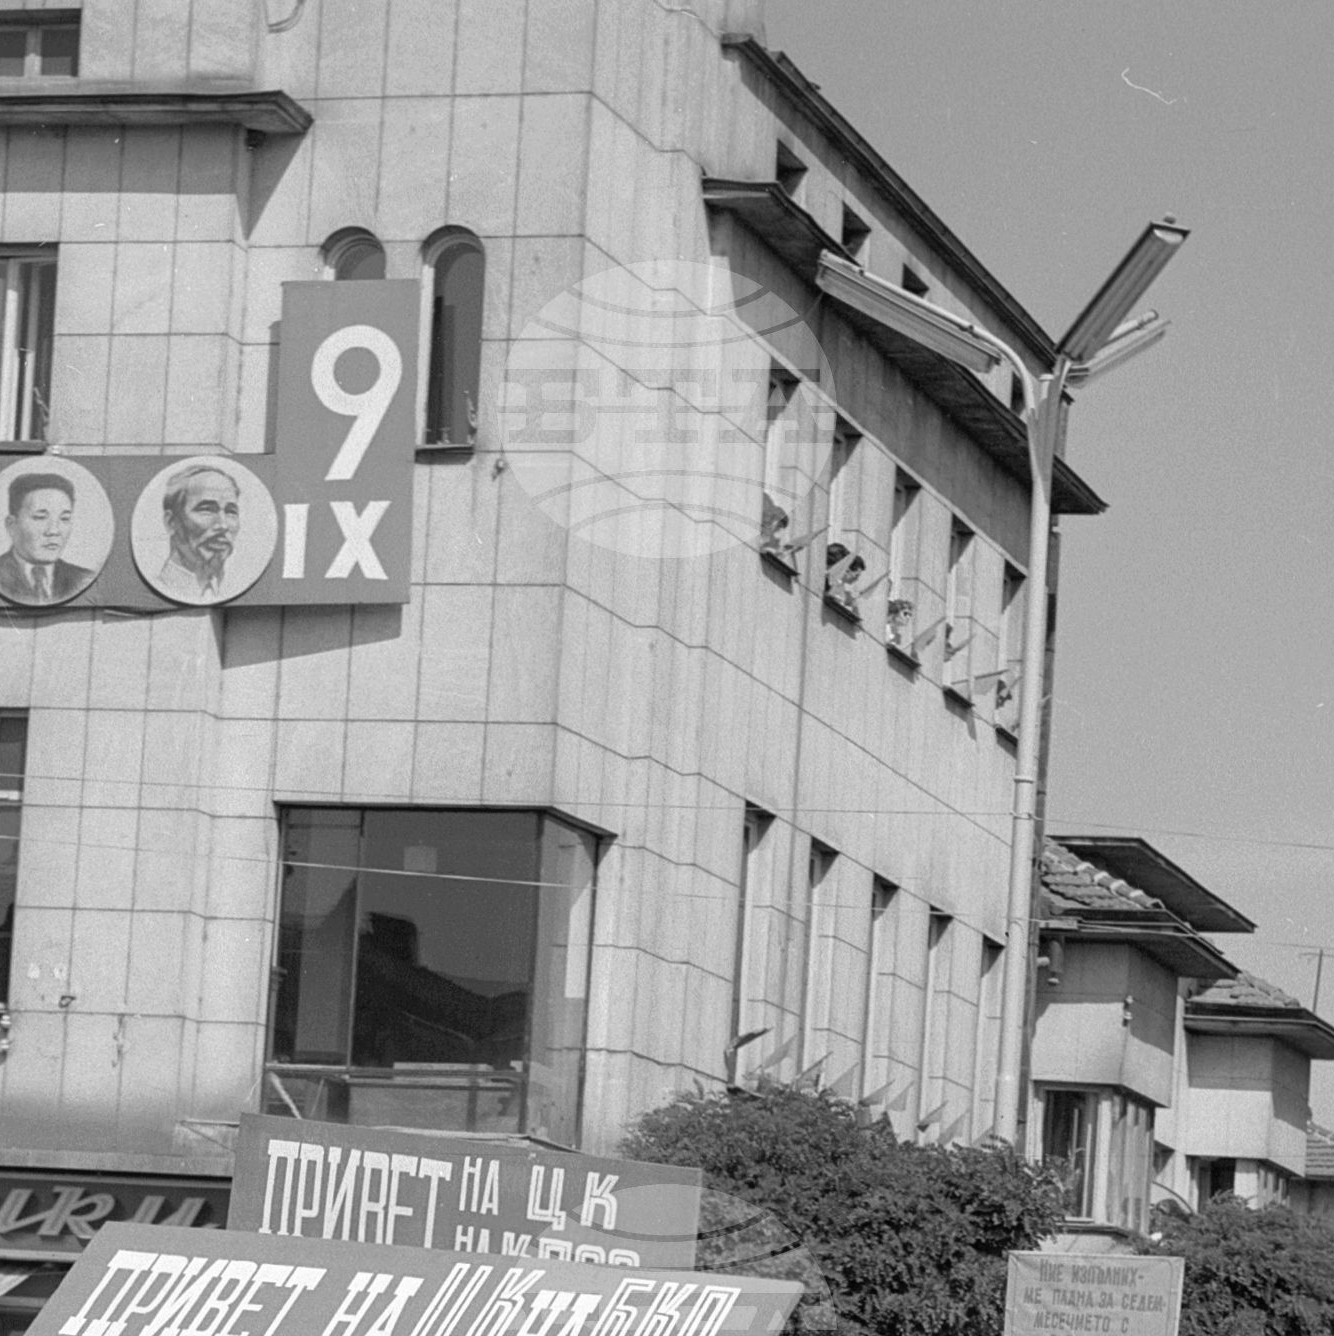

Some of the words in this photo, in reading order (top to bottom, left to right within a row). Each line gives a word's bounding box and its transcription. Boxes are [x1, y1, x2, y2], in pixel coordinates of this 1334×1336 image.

[311, 325, 403, 481] 9
[259, 1139, 453, 1249] ПРИВЕТ
[458, 1156, 500, 1216] НА
